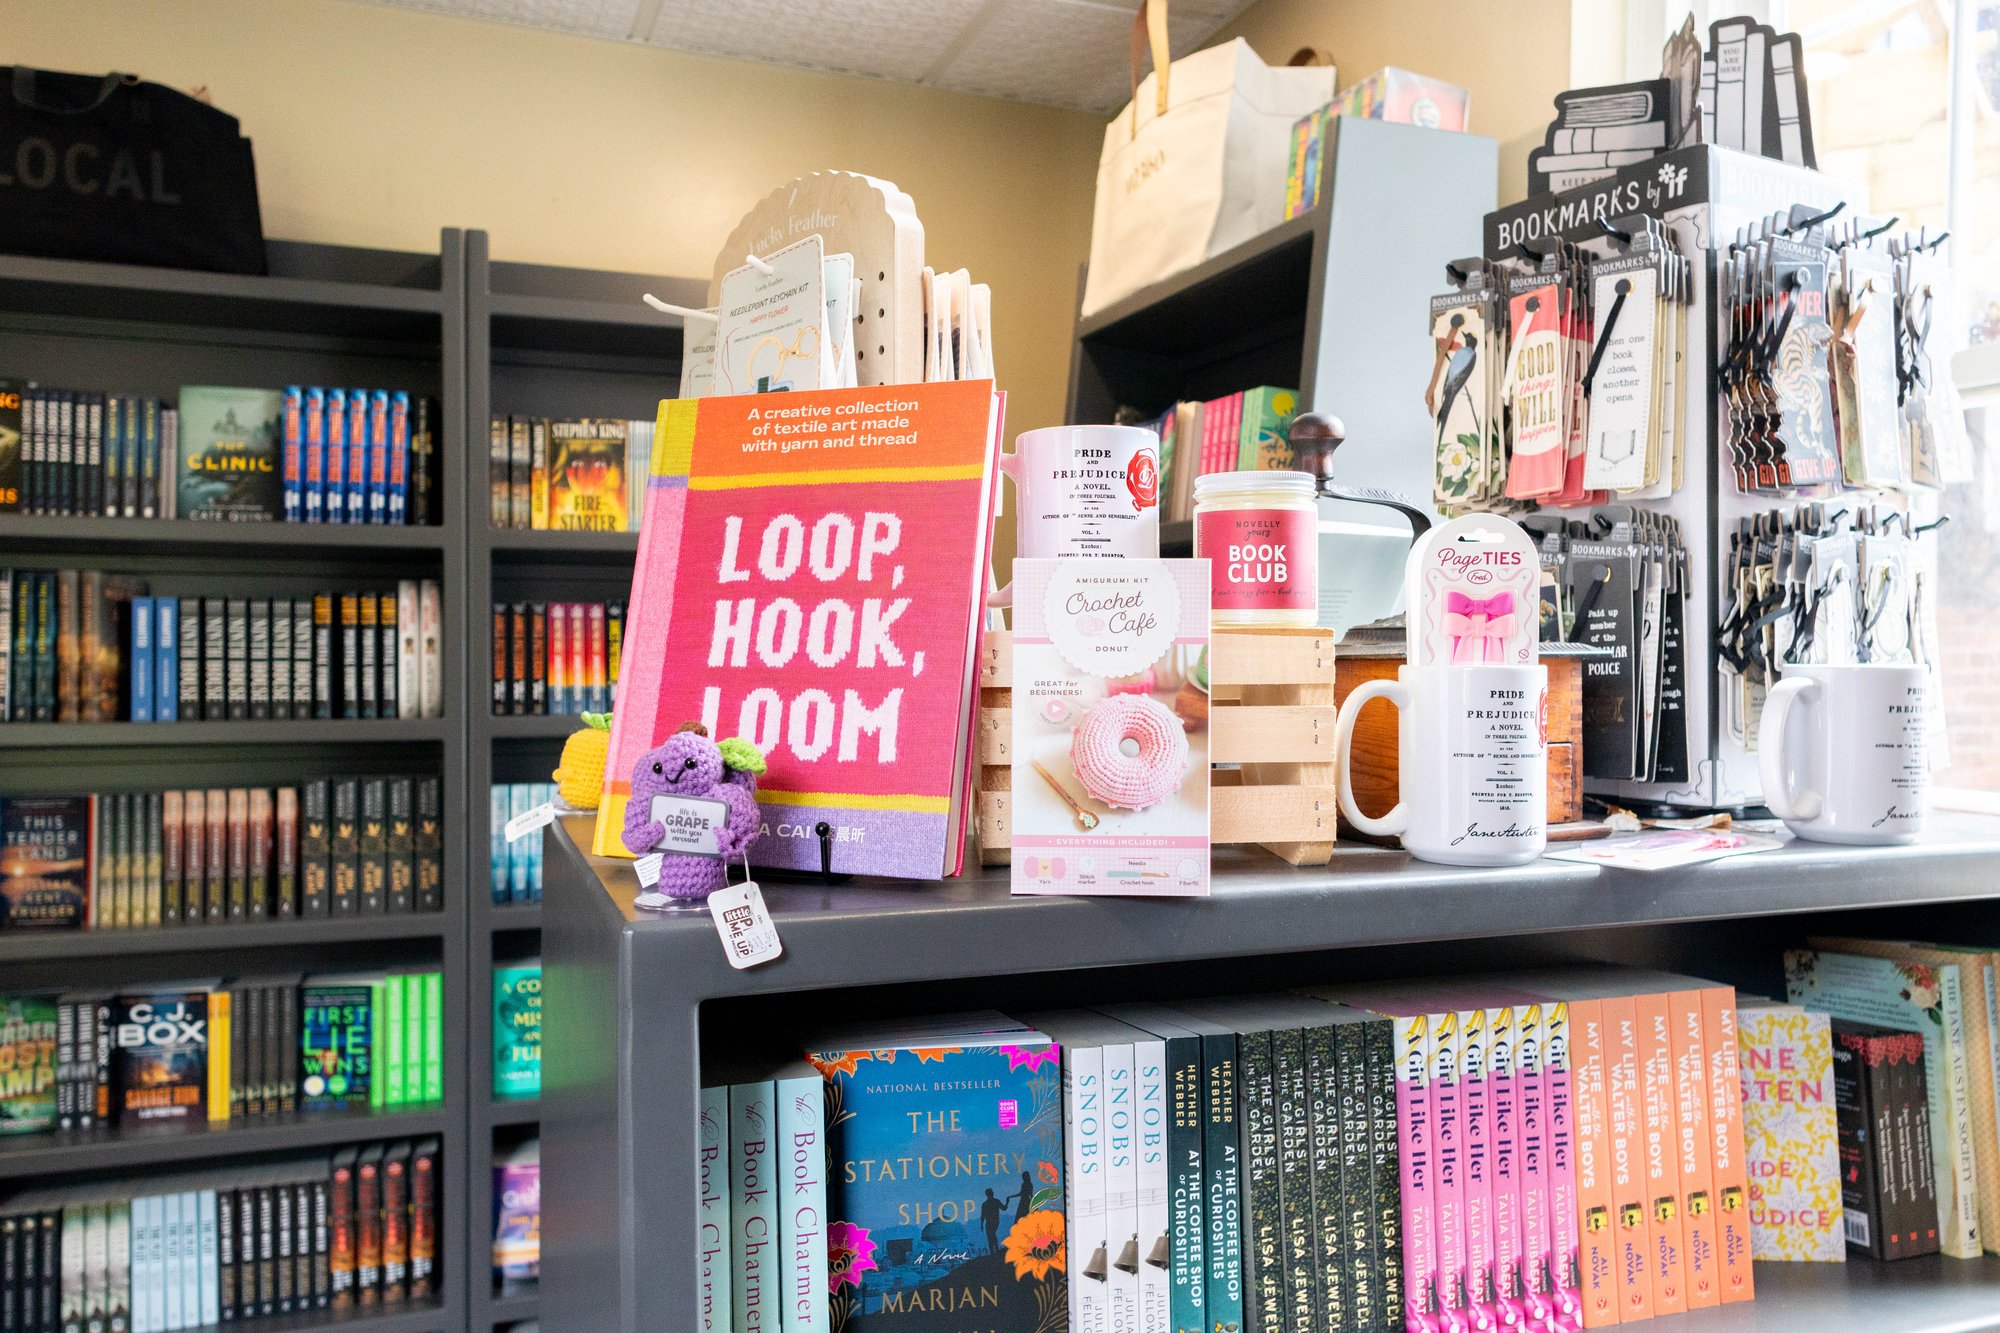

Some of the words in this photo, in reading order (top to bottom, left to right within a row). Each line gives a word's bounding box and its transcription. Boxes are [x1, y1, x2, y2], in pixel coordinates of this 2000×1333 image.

[1723, 47, 1739, 56] YOU
[1721, 64, 1743, 74] HERE
[787, 208, 839, 233] Feather
[1498, 181, 1640, 250] BOOKMARKS
[1647, 182, 1660, 209] by
[1773, 238, 1817, 257] BOOKMARKS
[1592, 257, 1644, 275] BOOKMARKS
[1510, 276, 1551, 289] BOOKMARKS
[729, 300, 768, 318] NEEDLEPOINT
[769, 287, 797, 304] KEYCHAIN
[798, 282, 809, 293] KIT
[1431, 293, 1477, 307] BOOKMARKS
[1629, 335, 1645, 344] one
[1518, 342, 1555, 380] GOOD
[1613, 350, 1633, 360] book
[1607, 364, 1637, 374] closes,
[1519, 377, 1556, 396] things
[1602, 378, 1640, 388] another
[1606, 394, 1634, 404] opens
[748, 408, 760, 420] A
[764, 404, 831, 420] creative
[835, 400, 919, 415] collection
[1518, 390, 1556, 429] WILL
[552, 422, 597, 438] STEPHEN
[599, 423, 626, 439] KING
[752, 423, 770, 436] of
[774, 420, 828, 435] textile
[831, 418, 858, 432] art
[861, 416, 910, 430] made
[1518, 424, 1557, 443] happen
[741, 439, 777, 453] with
[781, 438, 819, 454] yarn
[822, 435, 854, 448] and
[858, 431, 918, 447] thread
[186, 453, 274, 473] CLINIC
[1074, 449, 1112, 458] PRIDE
[1053, 470, 1126, 480] PREJUDICE
[1795, 457, 1819, 479] GIVE
[1822, 458, 1837, 478] UP
[559, 514, 617, 532] STARTER
[1236, 520, 1280, 528] NOVELLY
[1244, 530, 1272, 541] yours
[718, 511, 904, 590] LOOP,
[1229, 544, 1287, 562] BOOK
[1572, 544, 1622, 557] BOOKMARKS
[1228, 563, 1288, 583] CLUB
[1066, 591, 1143, 615] Crochet
[1588, 609, 1605, 618] Paid
[1608, 608, 1618, 618] up
[1109, 610, 1157, 636] Café
[1590, 621, 1617, 630] member
[707, 597, 925, 677] HOOK,
[1591, 634, 1601, 642] of
[1603, 633, 1616, 642] the
[1588, 662, 1621, 676] POLICE
[1490, 690, 1525, 699] PRIDE
[1467, 710, 1534, 719] PREJUDICE
[23, 815, 64, 830] THIS
[665, 815, 709, 830] GRAPE
[670, 828, 687, 836] with
[777, 823, 811, 838] CAI
[6, 831, 79, 846] TENDER
[1451, 823, 1499, 846] Jane
[18, 847, 69, 861] LAND
[725, 907, 751, 921] little
[729, 922, 743, 938] ME
[737, 940, 750, 956] UP
[303, 1006, 369, 1025] FIRST
[1721, 1009, 1733, 1036] MY
[117, 1020, 207, 1047] BOX
[303, 1026, 368, 1056] LIE
[1371, 1051, 1378, 1062] IN
[1550, 1035, 1566, 1074] Girl
[1723, 1040, 1736, 1077] LIFE
[303, 1056, 369, 1075] WINS
[866, 1083, 928, 1094] NATIONAL
[934, 1079, 1001, 1092] BESTSELLER
[1372, 1067, 1380, 1089] THE
[1384, 1062, 1395, 1093] THE
[1712, 1050, 1726, 1119] WALTER
[1175, 1070, 1184, 1127] WEBBER
[1187, 1064, 1197, 1127] HEATHER
[1552, 1081, 1567, 1126] Like
[907, 1110, 962, 1133] THE
[1080, 1074, 1099, 1175] SNOBS
[1142, 1066, 1161, 1164] SNOBS
[1373, 1095, 1385, 1164] GARDEN
[1385, 1102, 1397, 1151] GIRLS
[1555, 1132, 1569, 1170] Her
[1716, 1123, 1729, 1169] BOYS
[794, 1130, 818, 1195] Book
[845, 1151, 1026, 1184] STATIONERY
[1188, 1150, 1199, 1168] AT
[1179, 1175, 1186, 1186] OF
[1189, 1174, 1200, 1201] THE
[898, 1200, 976, 1226] SHOP
[1555, 1185, 1566, 1225] TALIA
[1175, 1188, 1188, 1285] CURIOSITIES
[1190, 1204, 1201, 1261] COFFEE
[1383, 1209, 1396, 1249] LISA
[1726, 1225, 1736, 1266] NOVAK
[1735, 1236, 1743, 1254] ALI
[795, 1206, 819, 1323] Charmer
[914, 1254, 923, 1265] A
[1557, 1230, 1569, 1289] HIBBERT
[1191, 1264, 1202, 1308] SHOP
[1385, 1256, 1399, 1327] JEWELL
[880, 1285, 998, 1316] MARJAN
